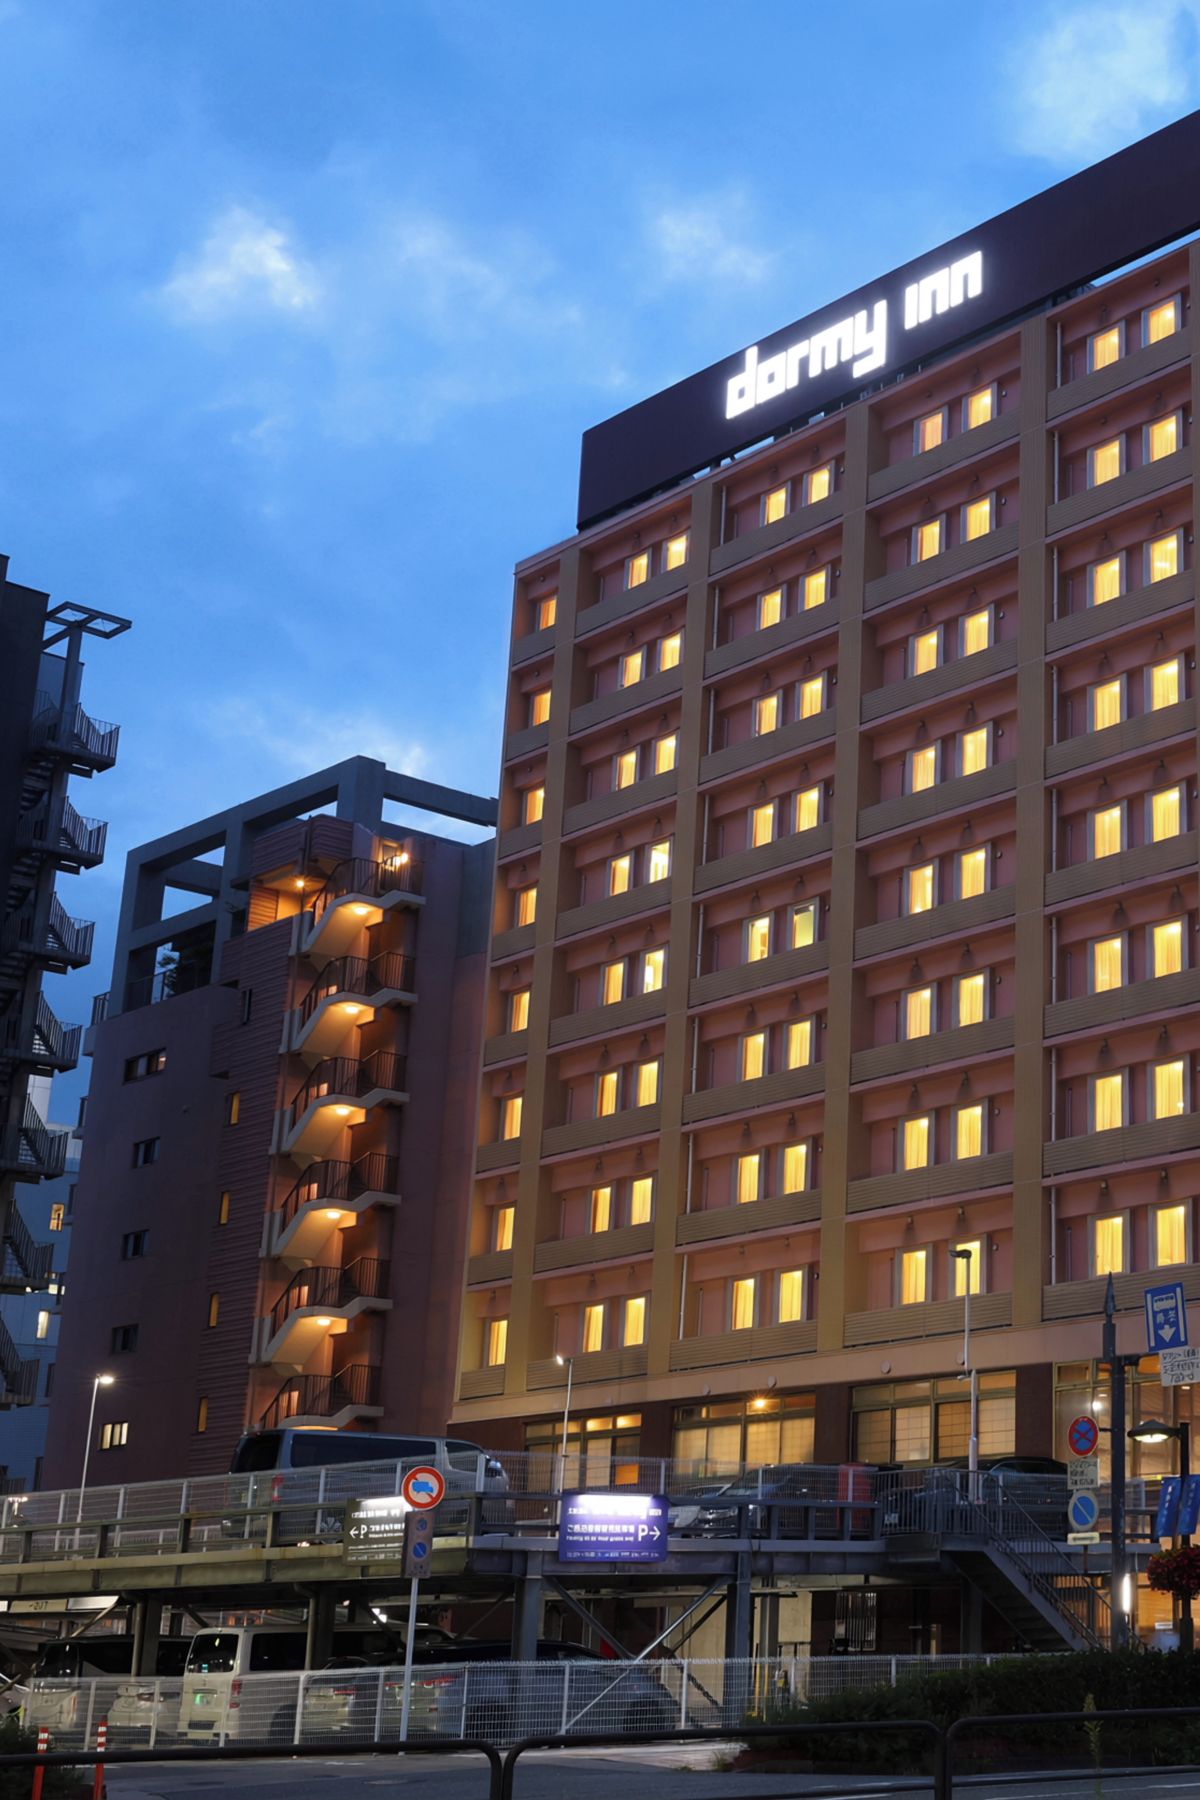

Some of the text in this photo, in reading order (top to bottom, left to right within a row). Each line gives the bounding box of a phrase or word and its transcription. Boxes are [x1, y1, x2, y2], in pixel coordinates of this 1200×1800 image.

[726, 249, 984, 420] dormy inn
[637, 1524, 649, 1542] P
